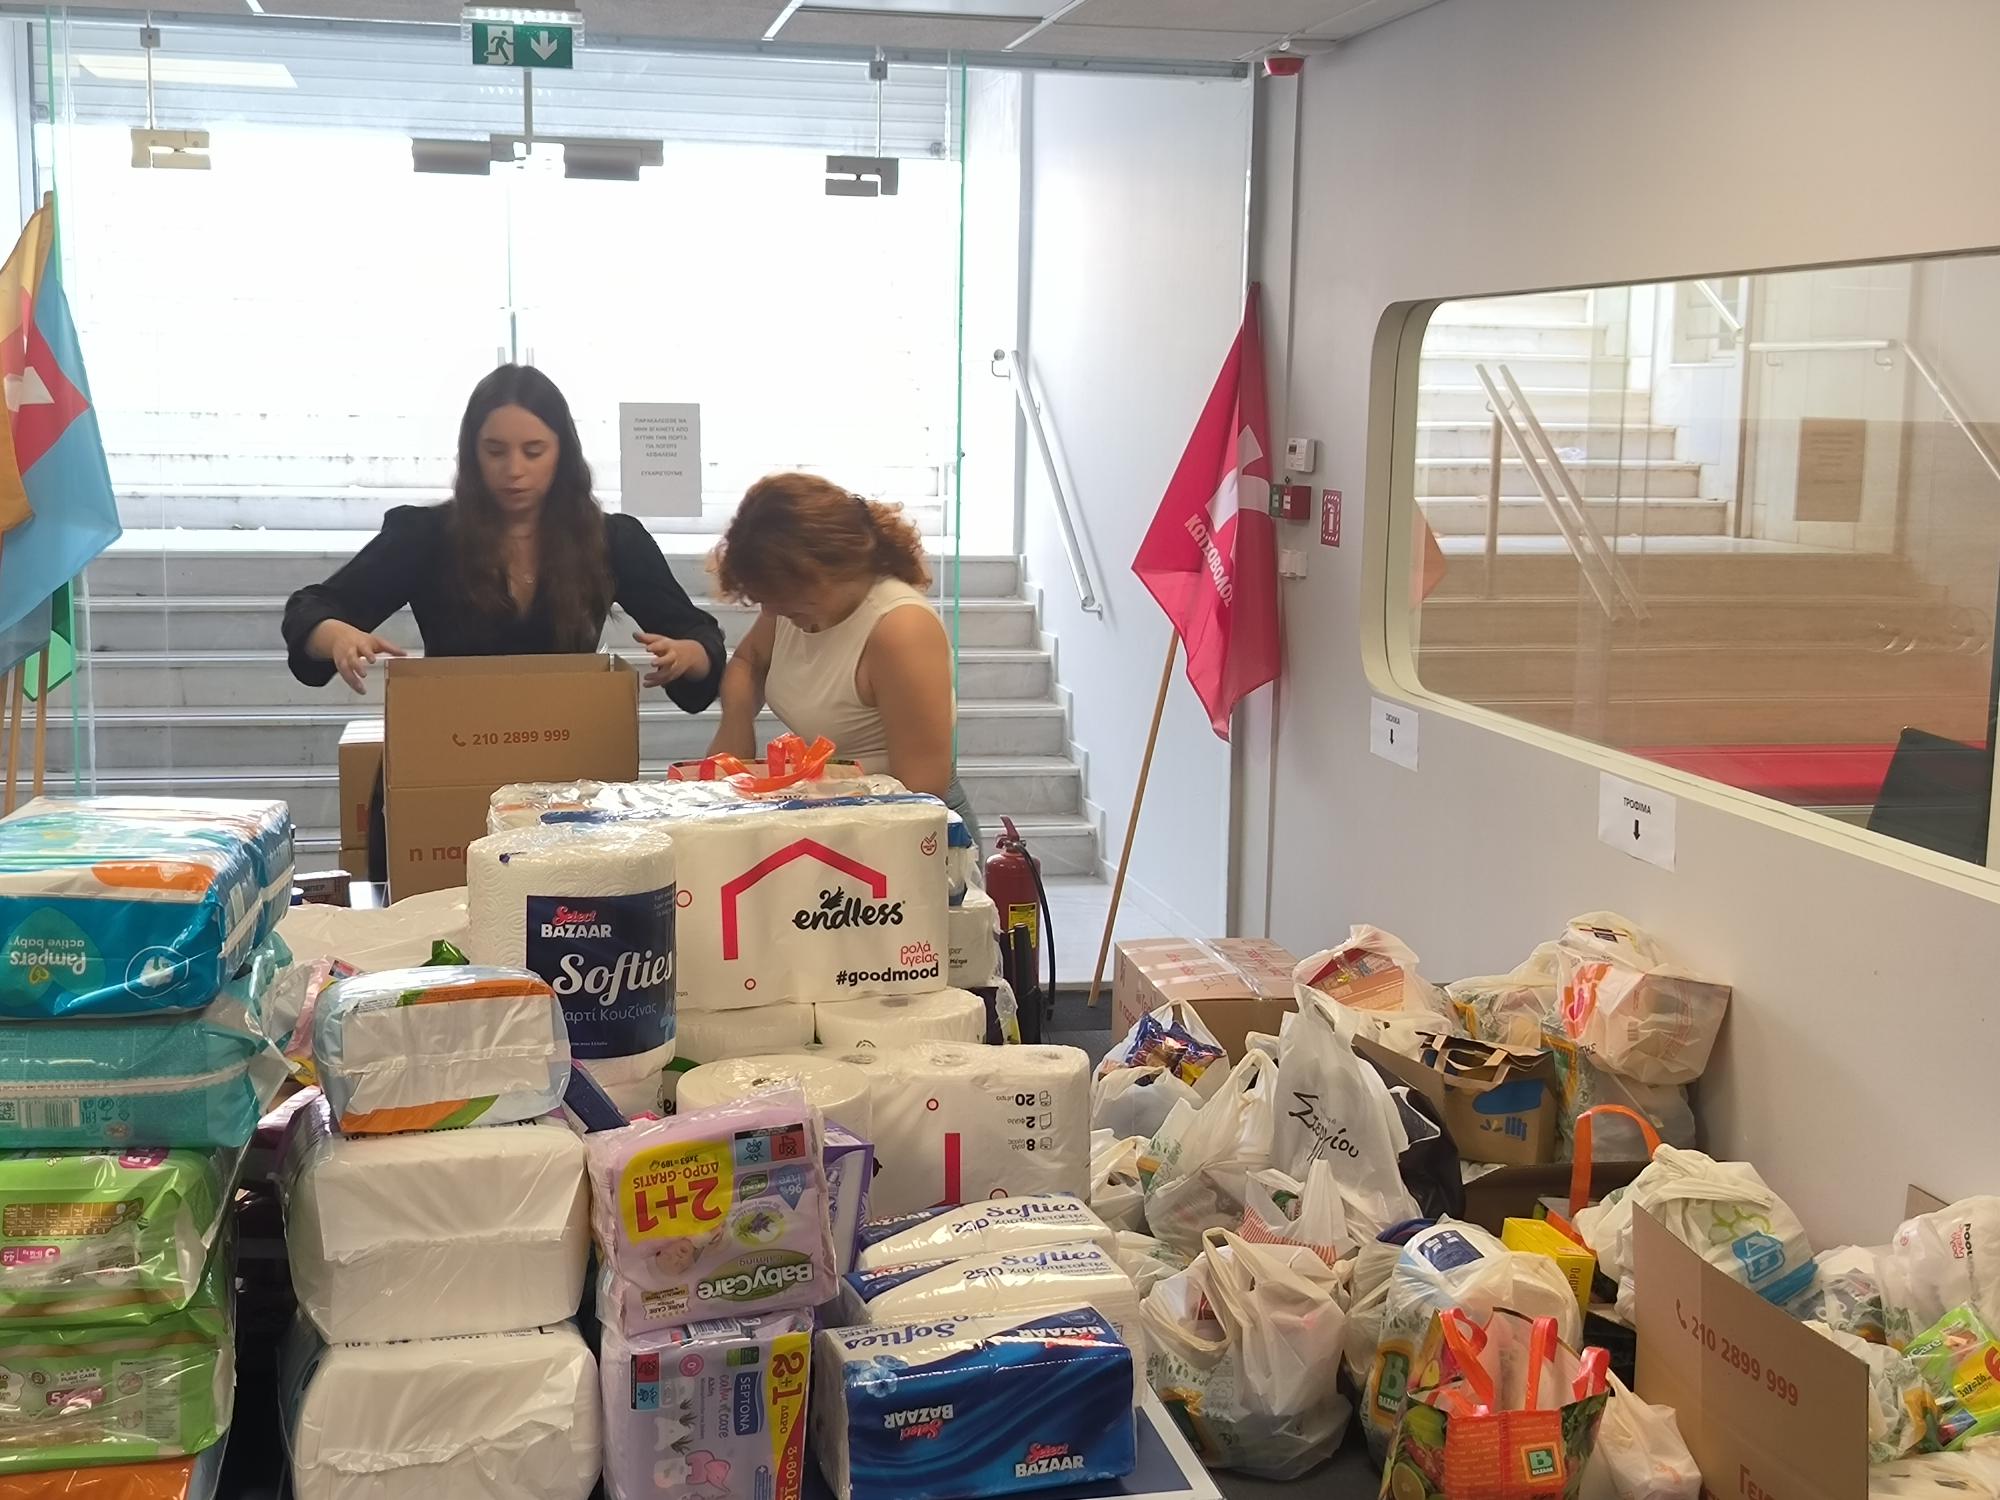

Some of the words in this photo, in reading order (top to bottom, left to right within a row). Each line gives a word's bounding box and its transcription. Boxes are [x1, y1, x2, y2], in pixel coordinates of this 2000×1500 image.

[472, 733, 498, 746] 210
[503, 731, 539, 744] 2899
[543, 729, 570, 742] 999
[1623, 797, 1652, 815] ΤΡΟΦΙΜΑ
[553, 906, 597, 926] Select
[792, 898, 904, 931] endless
[15, 936, 45, 948] baby
[47, 938, 85, 948] active
[541, 924, 613, 939] BAZAAR
[9, 951, 87, 975] Pampers
[836, 963, 939, 987] #goodmood
[553, 950, 673, 1006] Softies
[563, 1007, 597, 1024] αρτί
[600, 1002, 657, 1021] Κουζίνας
[1015, 1093, 1035, 1106] 20
[1026, 1116, 1036, 1128] 2
[1026, 1138, 1036, 1151] 8
[634, 1177, 722, 1232] 2+1
[863, 1212, 932, 1227] AZAAR
[699, 1263, 814, 1299] BabyCare
[844, 1323, 955, 1350] Softies
[1692, 1316, 1716, 1351] 210
[1721, 1338, 1761, 1382] 2899
[1766, 1369, 1799, 1407] 999
[771, 1353, 808, 1405] 2+1
[739, 1376, 751, 1432] SEPTONA
[718, 1414, 729, 1438] care
[884, 1404, 954, 1430] BAZAAR
[1015, 1454, 1086, 1479] BAZAAR
